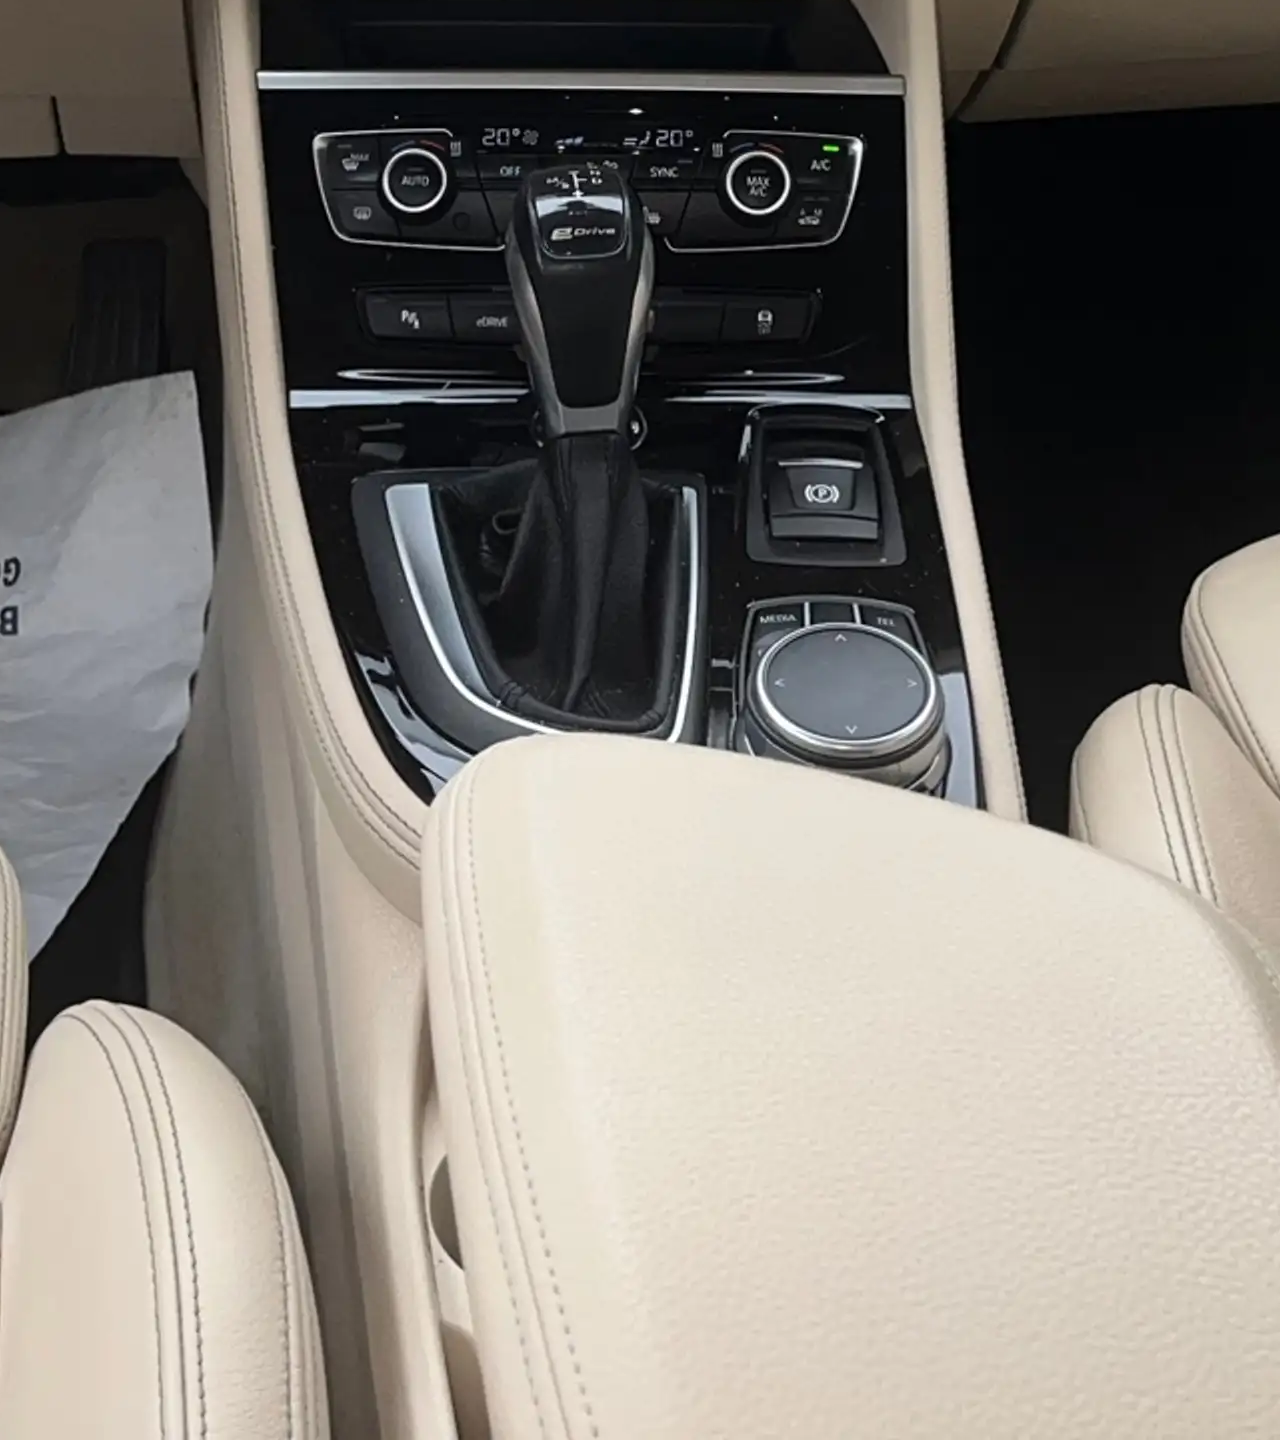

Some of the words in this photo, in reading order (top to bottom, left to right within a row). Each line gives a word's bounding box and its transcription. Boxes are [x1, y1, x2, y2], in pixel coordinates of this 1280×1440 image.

[650, 167, 679, 178] SYNC
[401, 176, 430, 186] AUTO
[746, 177, 770, 187] MAX
